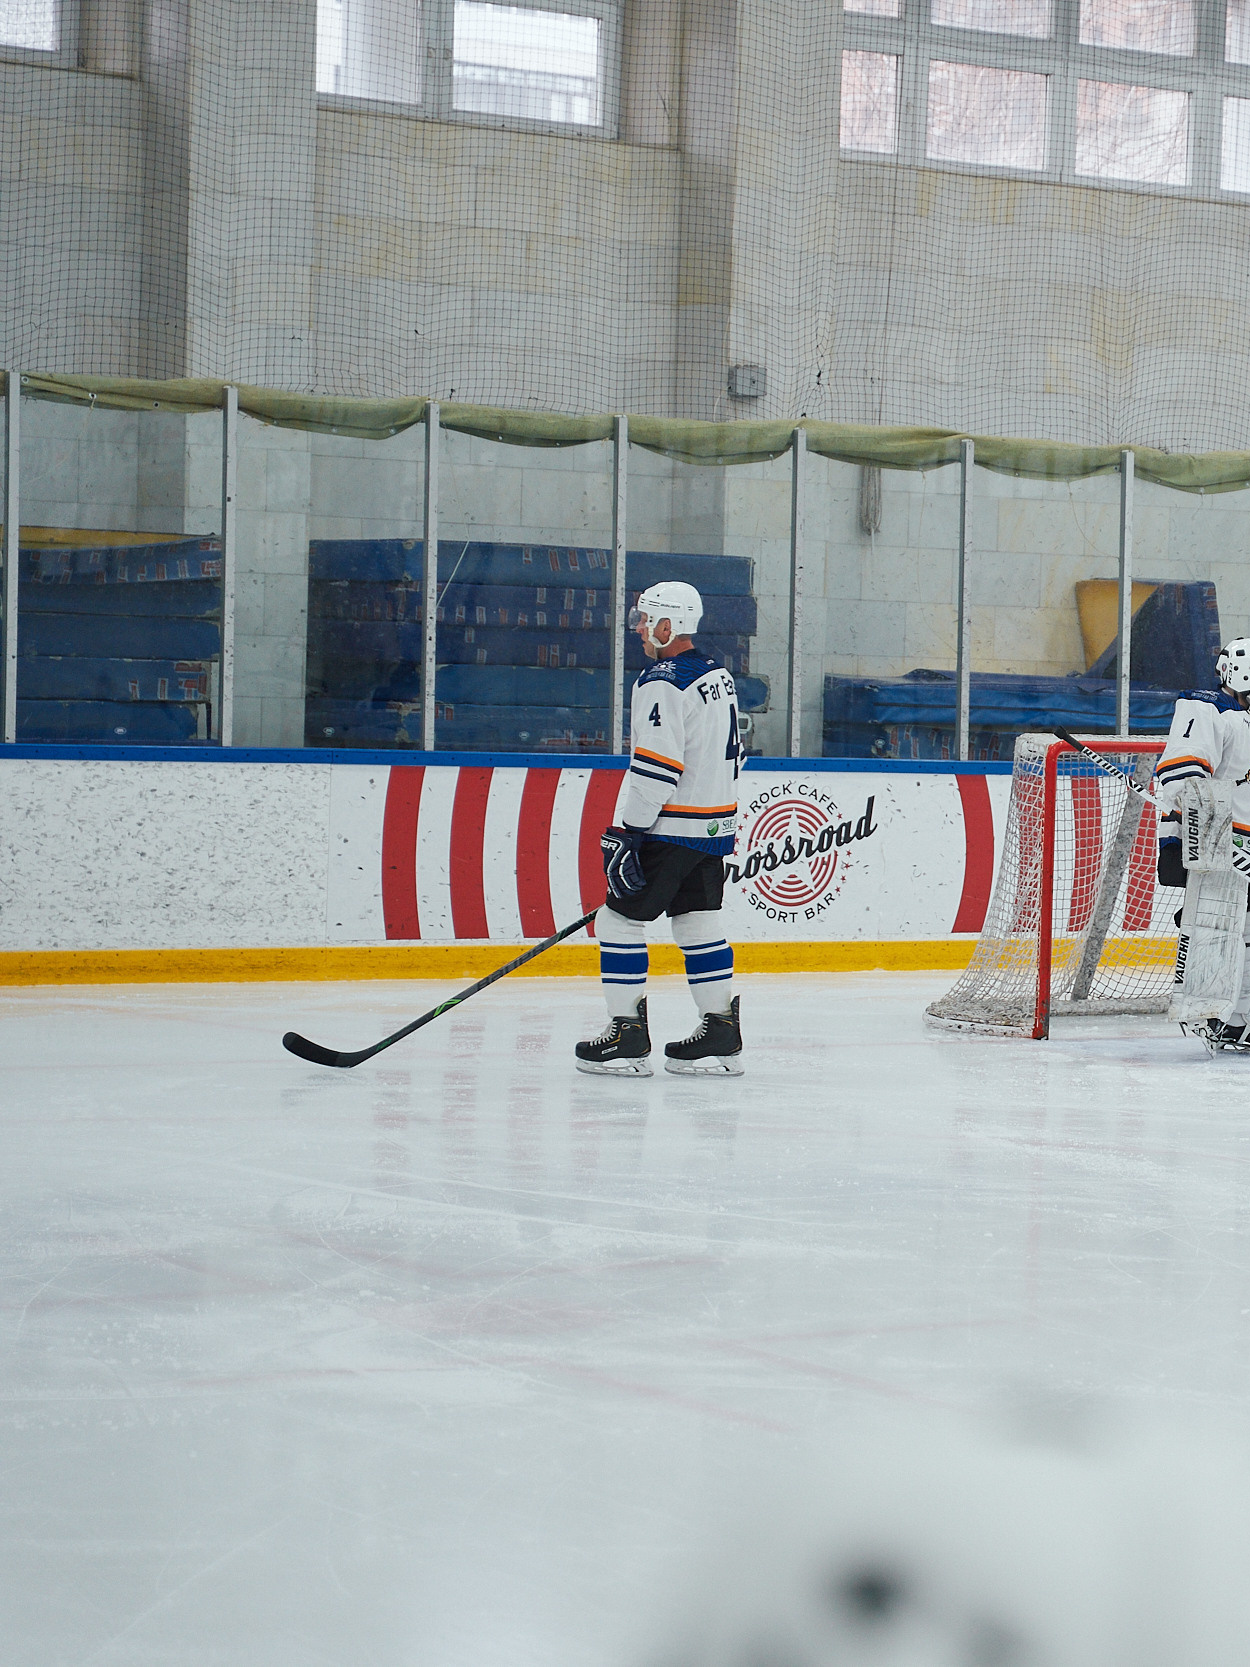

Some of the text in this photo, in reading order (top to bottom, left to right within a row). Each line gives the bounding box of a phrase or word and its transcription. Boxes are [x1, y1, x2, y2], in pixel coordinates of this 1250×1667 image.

[697, 674, 738, 705] Far Ea
[648, 702, 662, 727] 4
[1182, 718, 1195, 738] 1
[725, 703, 740, 781] 4
[749, 783, 838, 815] ROCK CAFE
[722, 795, 878, 884] rossroad
[1188, 807, 1199, 862] VAUGHN
[748, 892, 835, 923] SPORT BAR
[1174, 933, 1191, 984] VAUGHN
